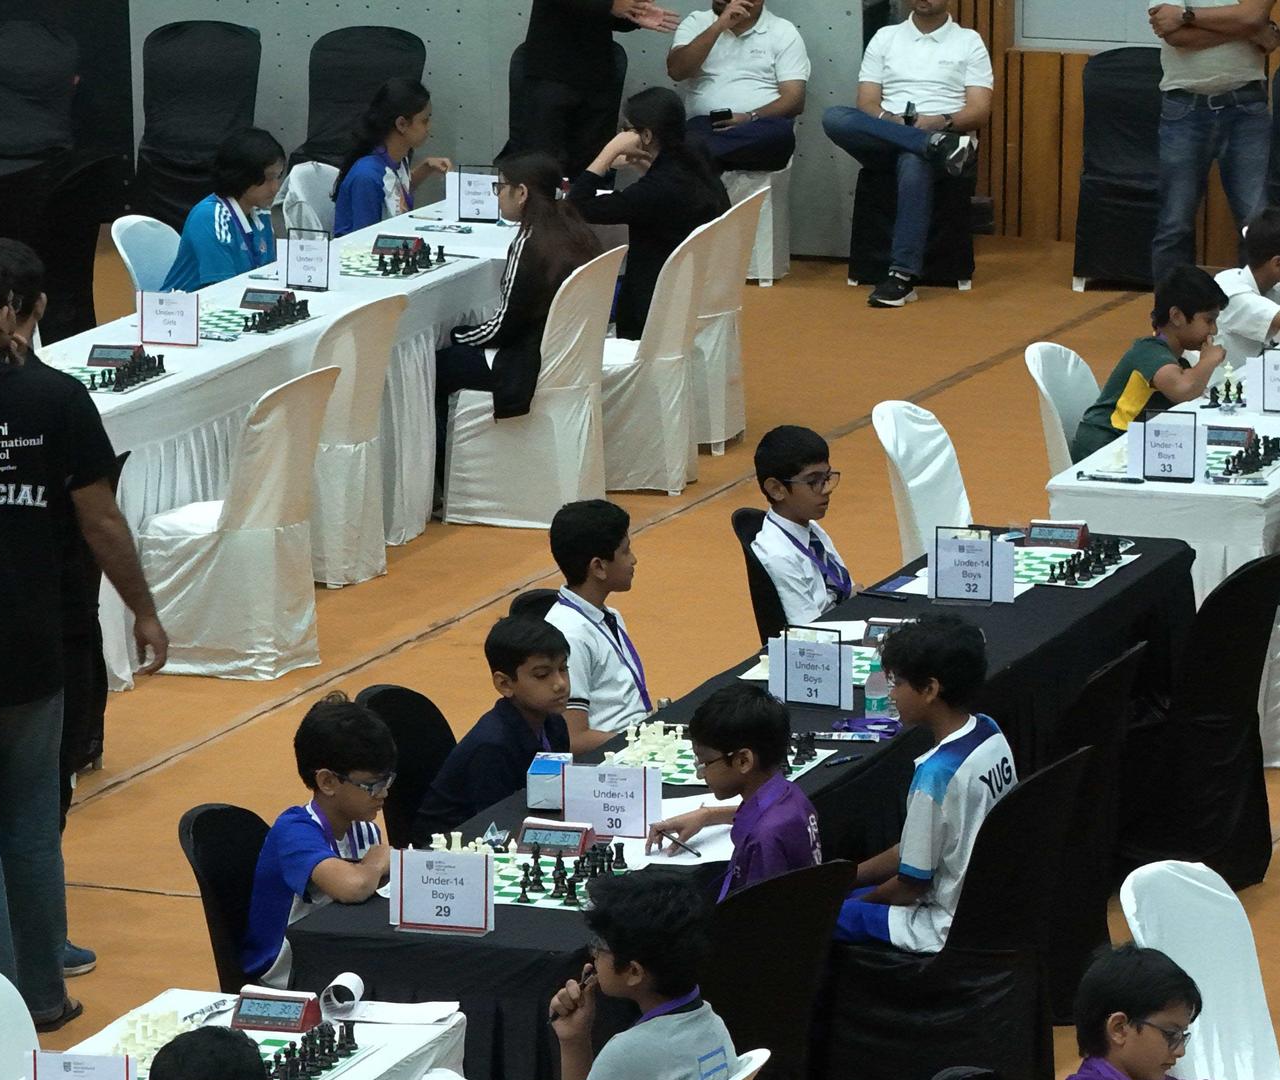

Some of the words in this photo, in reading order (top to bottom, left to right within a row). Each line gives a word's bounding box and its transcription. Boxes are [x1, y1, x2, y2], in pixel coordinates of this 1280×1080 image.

[307, 275, 312, 283] 2
[1150, 441, 1183, 449] Under-14
[1158, 452, 1175, 460] Boys
[1160, 464, 1173, 472] 33
[954, 559, 990, 567] Under-14
[962, 570, 982, 579] Boys
[965, 583, 978, 593] 32
[795, 661, 831, 671] Under-14
[803, 673, 823, 684] Boys
[806, 688, 818, 698] 31
[979, 756, 1012, 799] YUG
[593, 789, 635, 800] Under-14
[603, 803, 625, 813] Boys
[606, 818, 621, 828] 30
[421, 876, 464, 887] Under-14
[431, 890, 455, 901] Boys
[435, 906, 450, 917] 29
